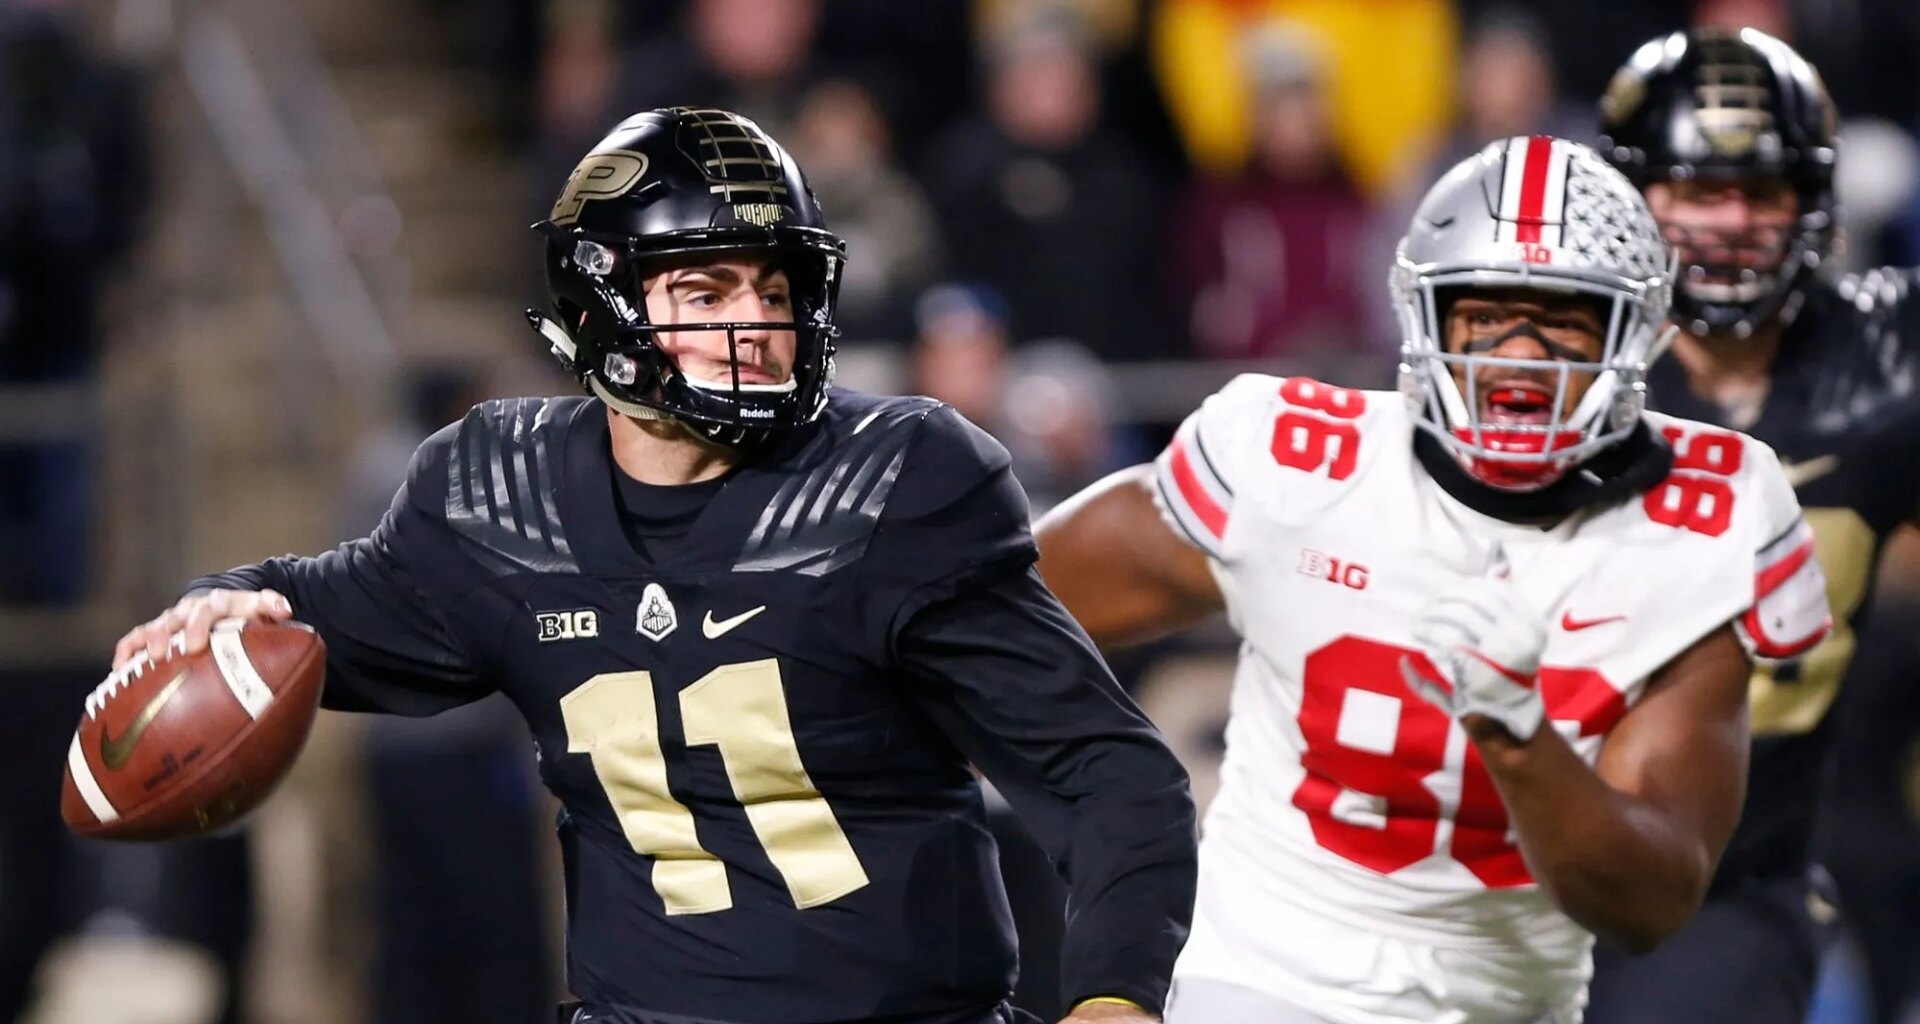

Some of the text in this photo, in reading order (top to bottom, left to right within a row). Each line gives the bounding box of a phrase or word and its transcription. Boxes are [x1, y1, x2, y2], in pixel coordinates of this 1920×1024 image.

[739, 408, 775, 418] Riddell
[1270, 376, 1366, 481] 86
[1643, 425, 1743, 537] 86
[559, 657, 870, 916] 11
